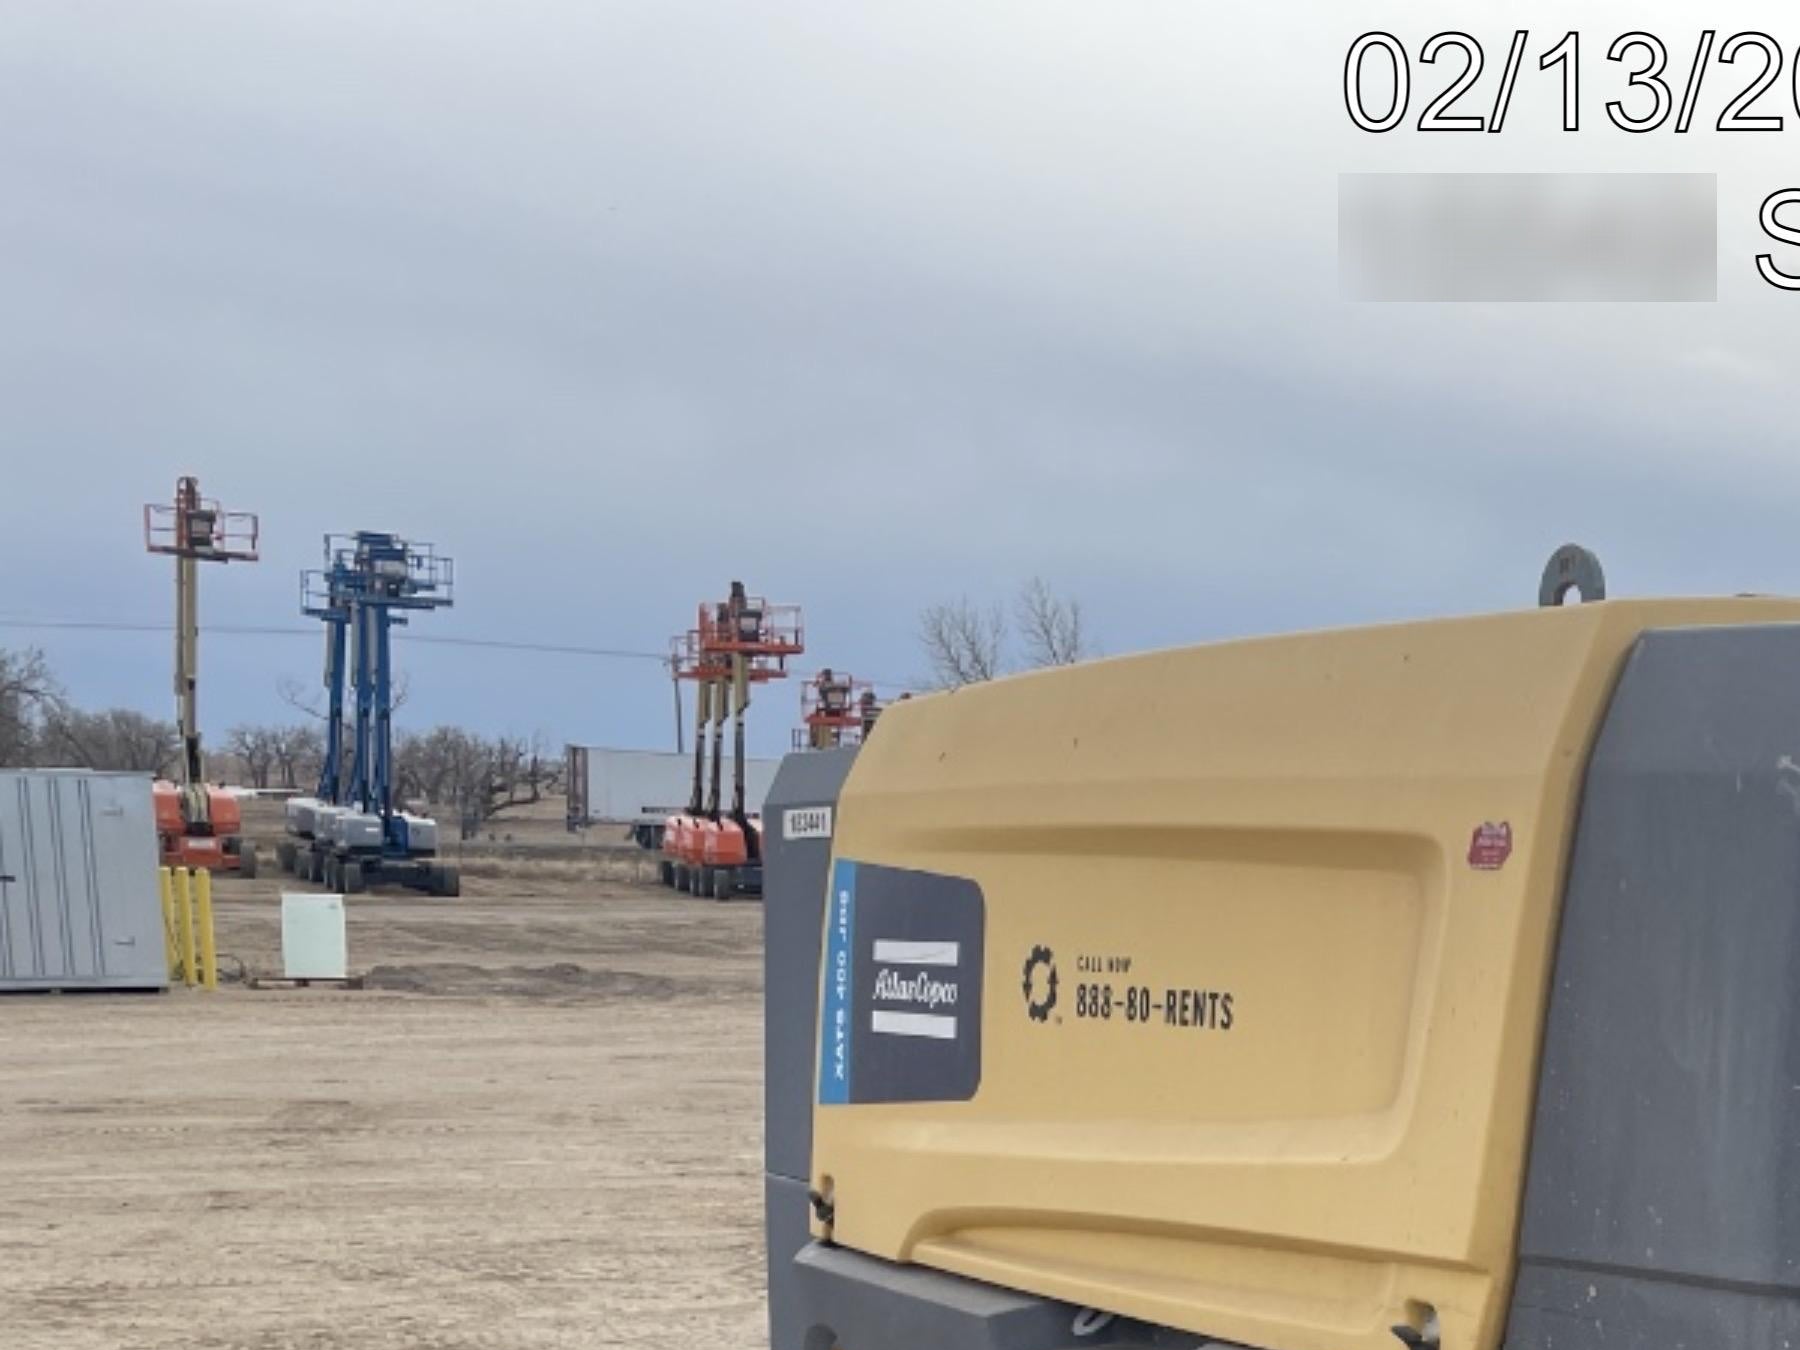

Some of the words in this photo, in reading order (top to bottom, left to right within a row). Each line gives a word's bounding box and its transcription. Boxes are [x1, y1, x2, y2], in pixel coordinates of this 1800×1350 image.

[1076, 955, 1103, 973] CALL
[1107, 956, 1132, 973] NOW
[1076, 982, 1234, 1030] 888-80-RENTS
